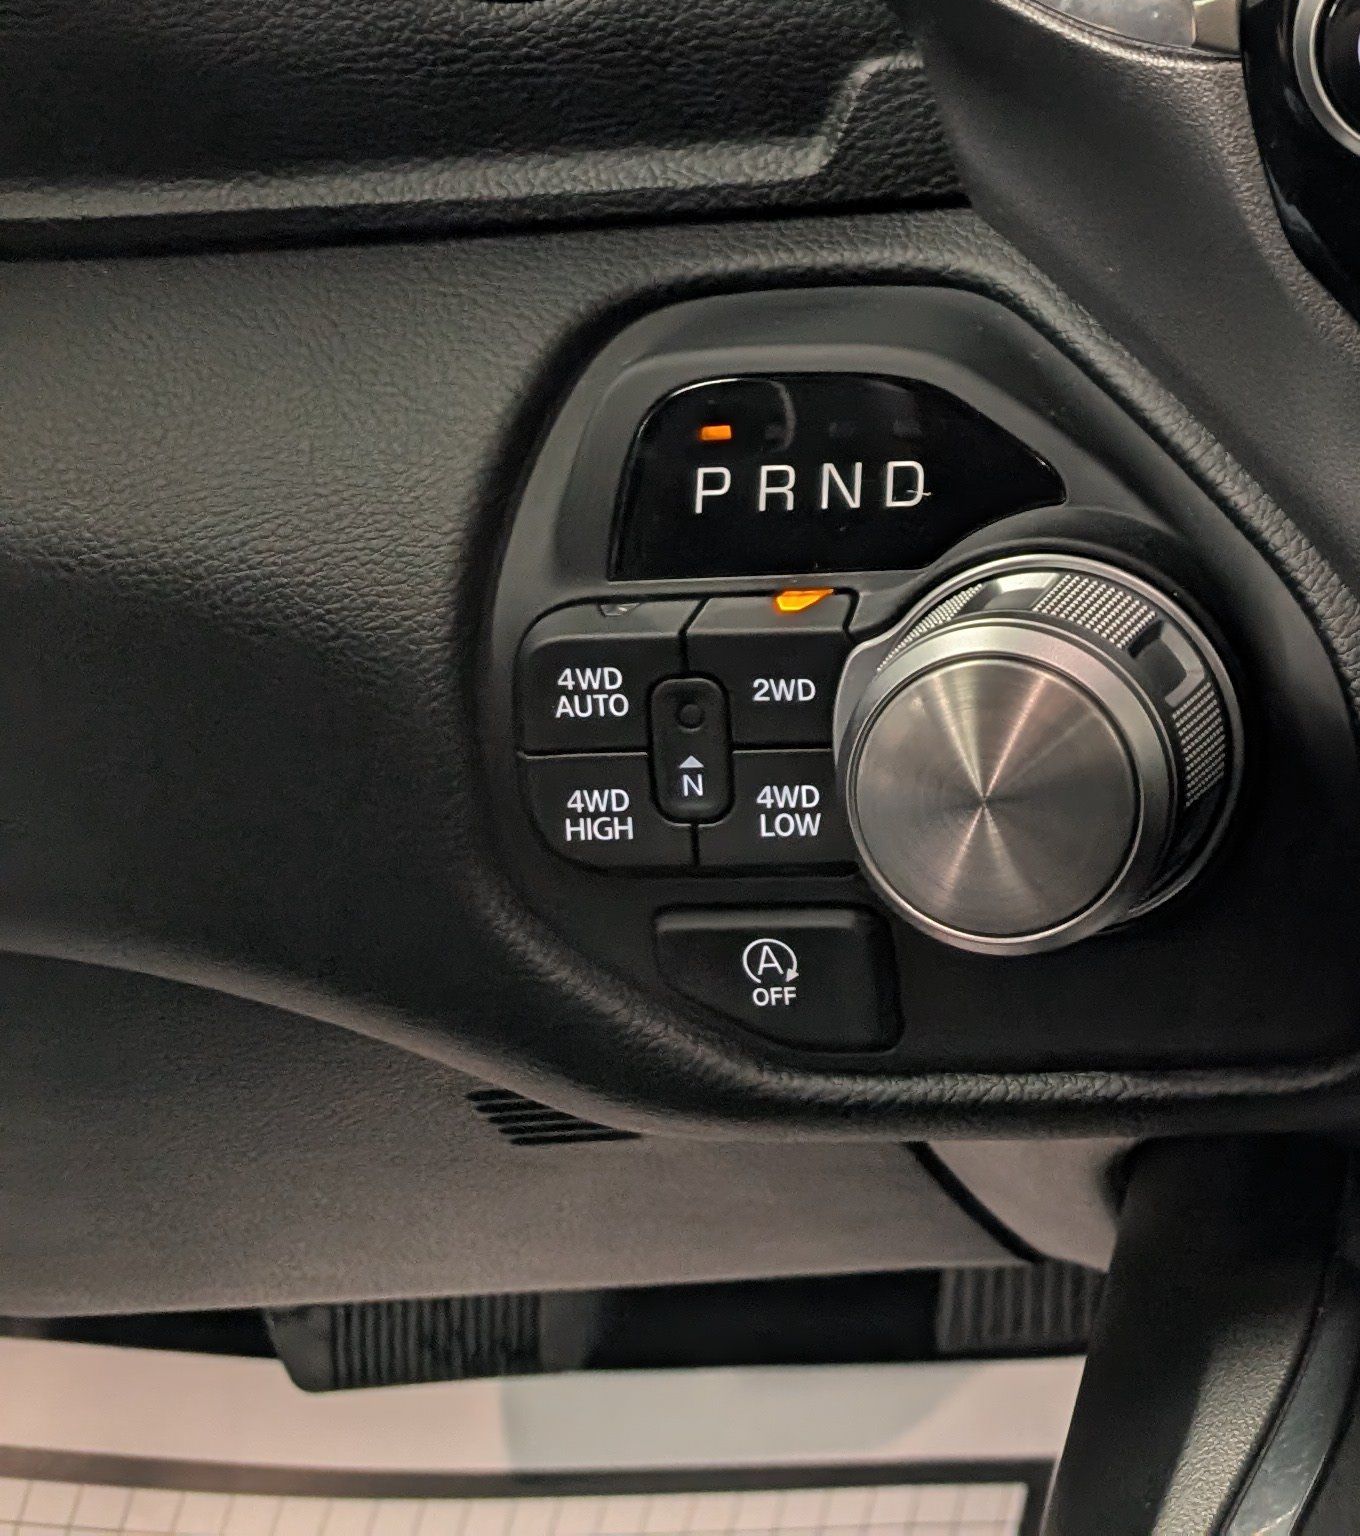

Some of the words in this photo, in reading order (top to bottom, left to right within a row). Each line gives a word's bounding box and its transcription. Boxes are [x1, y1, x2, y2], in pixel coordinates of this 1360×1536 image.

[694, 466, 731, 514] P
[758, 464, 796, 512] R
[820, 462, 863, 509] N
[883, 460, 926, 508] D
[556, 668, 623, 692] 4WD
[752, 678, 816, 703] 2WD
[555, 693, 630, 720] AUTO
[682, 773, 704, 797] N
[756, 785, 820, 809] 4WD
[567, 789, 630, 813] 4WD
[564, 815, 634, 842] HIGH
[759, 813, 821, 839] LOW
[752, 987, 797, 1007] OFF
